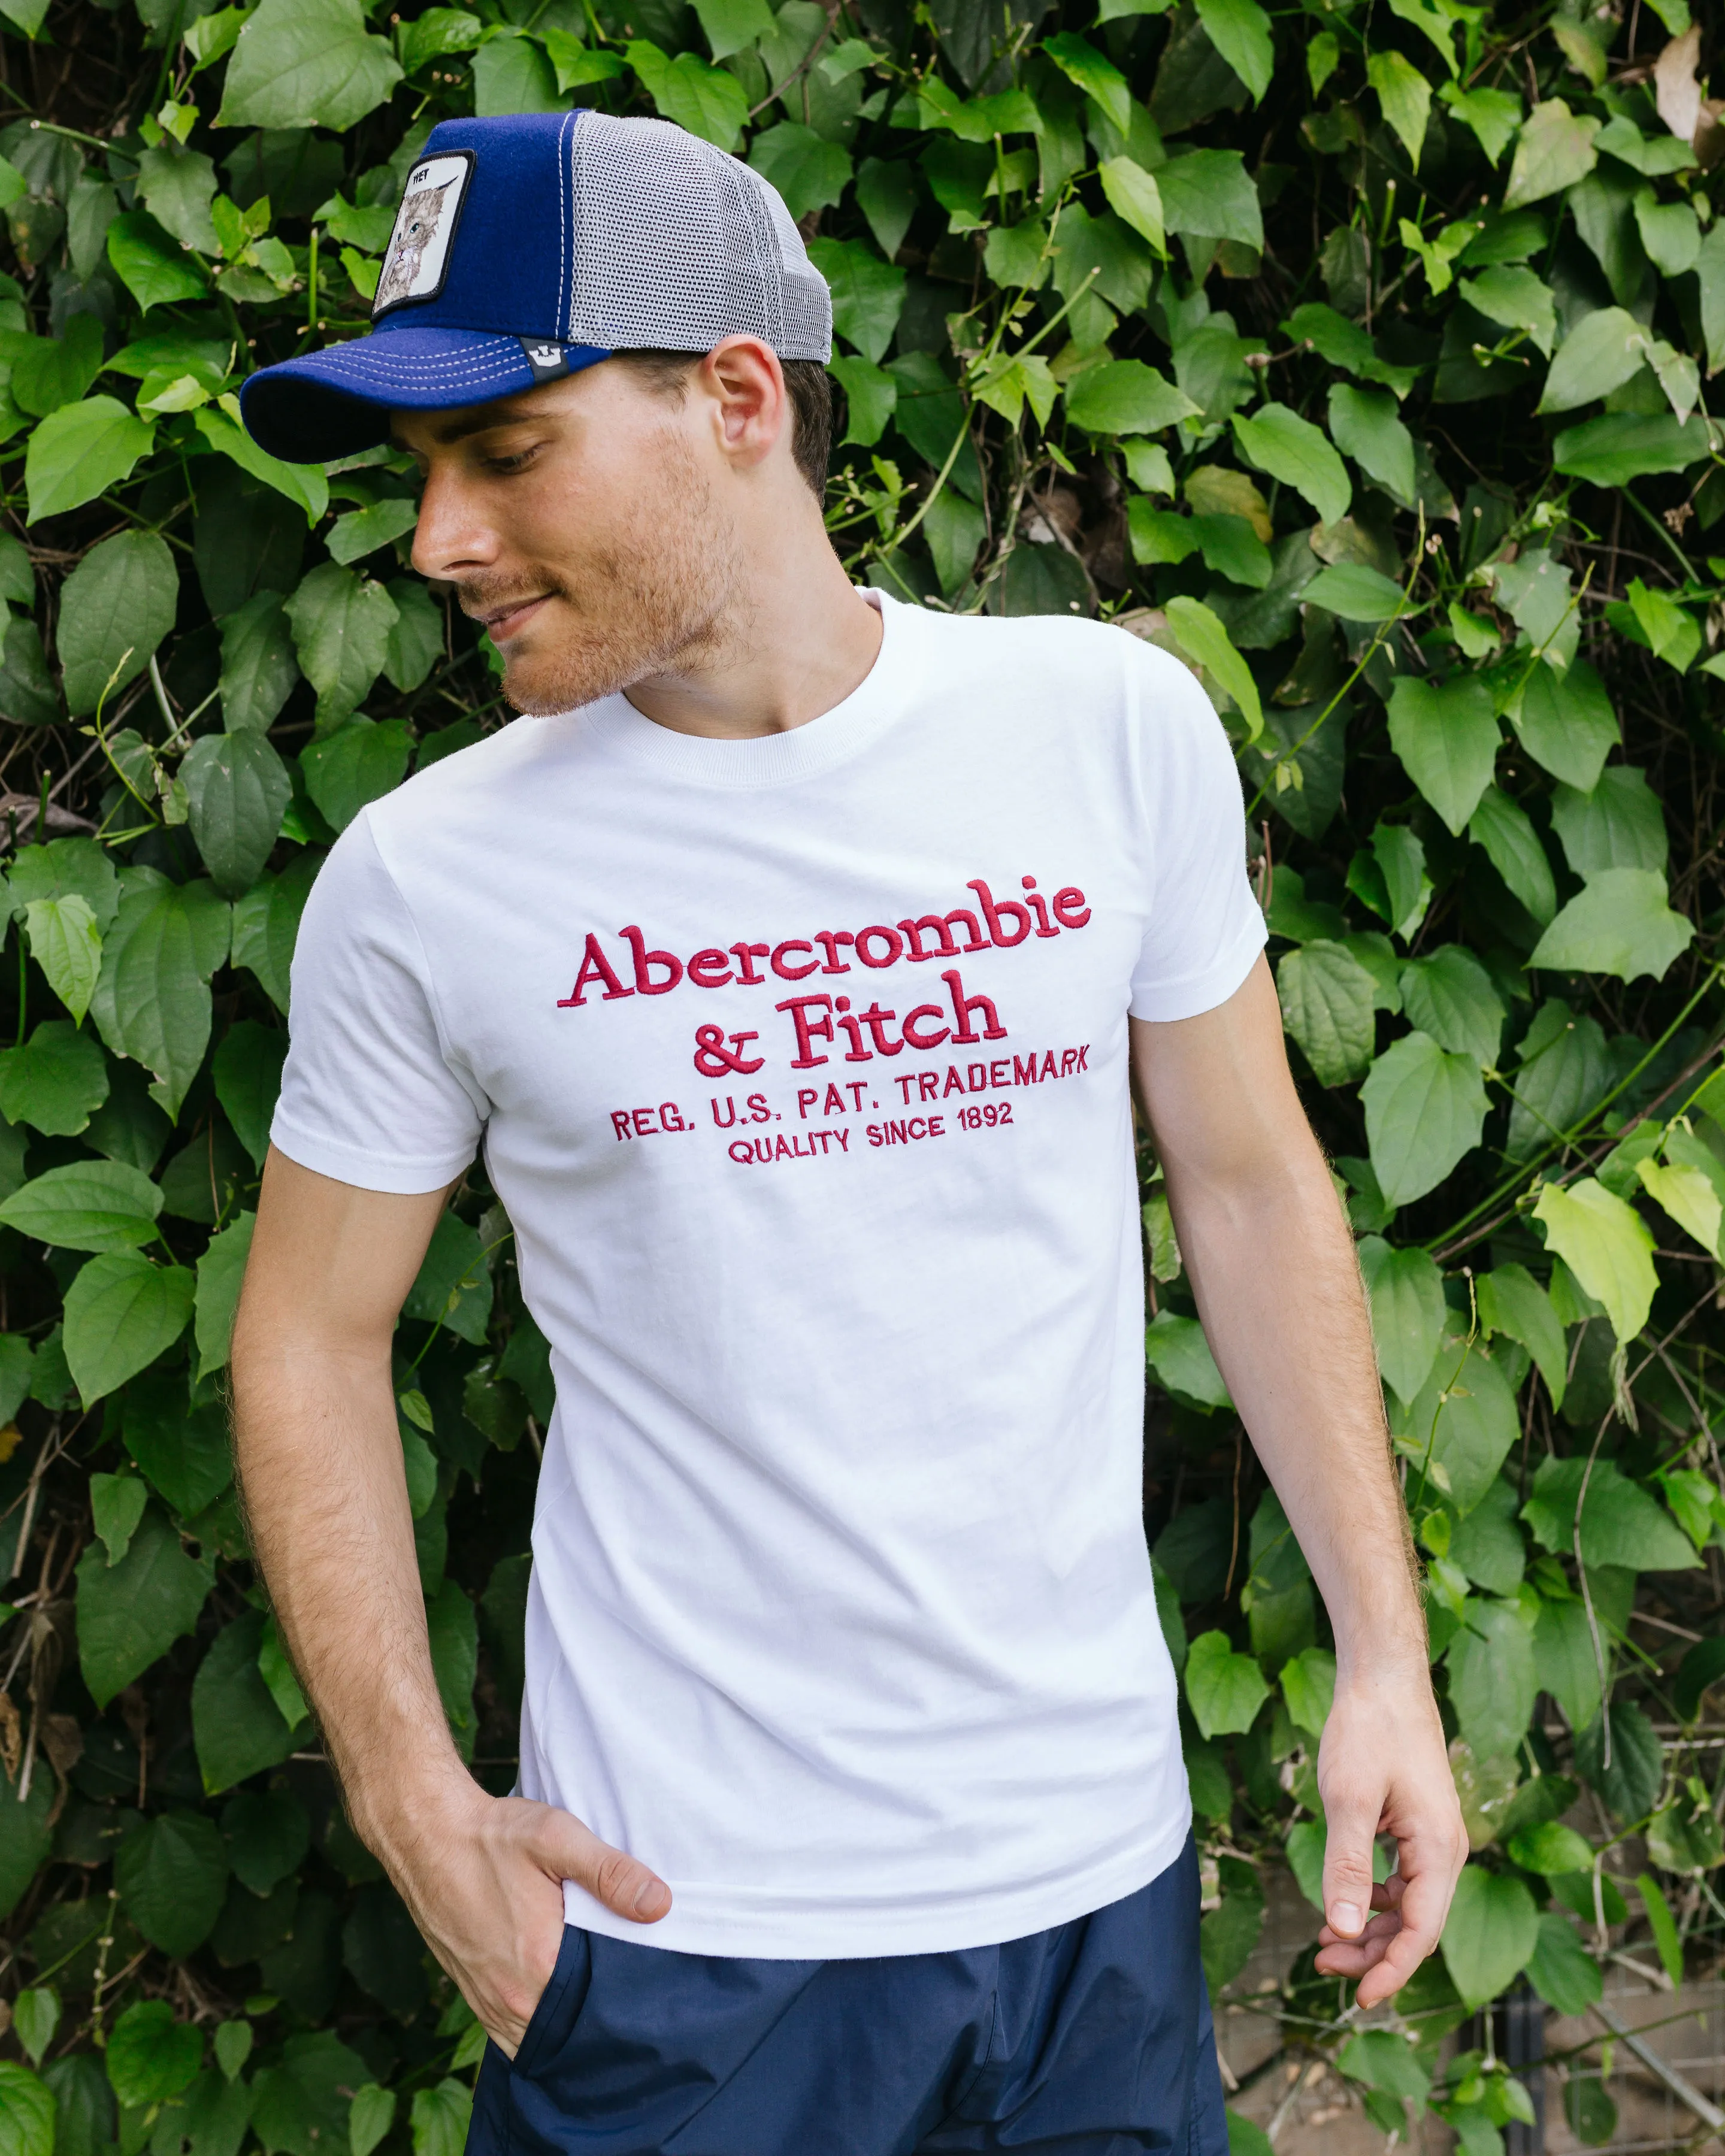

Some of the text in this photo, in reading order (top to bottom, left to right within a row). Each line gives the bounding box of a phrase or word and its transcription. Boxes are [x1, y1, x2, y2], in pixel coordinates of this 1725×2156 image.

[557, 875, 1091, 1007] Abercrombie
[694, 969, 1007, 1077] & Fitch
[610, 1044, 1091, 1141] REG. U.S. PAT. TRADEMARK
[728, 1101, 1014, 1165] QUALITY SINCE 1892
